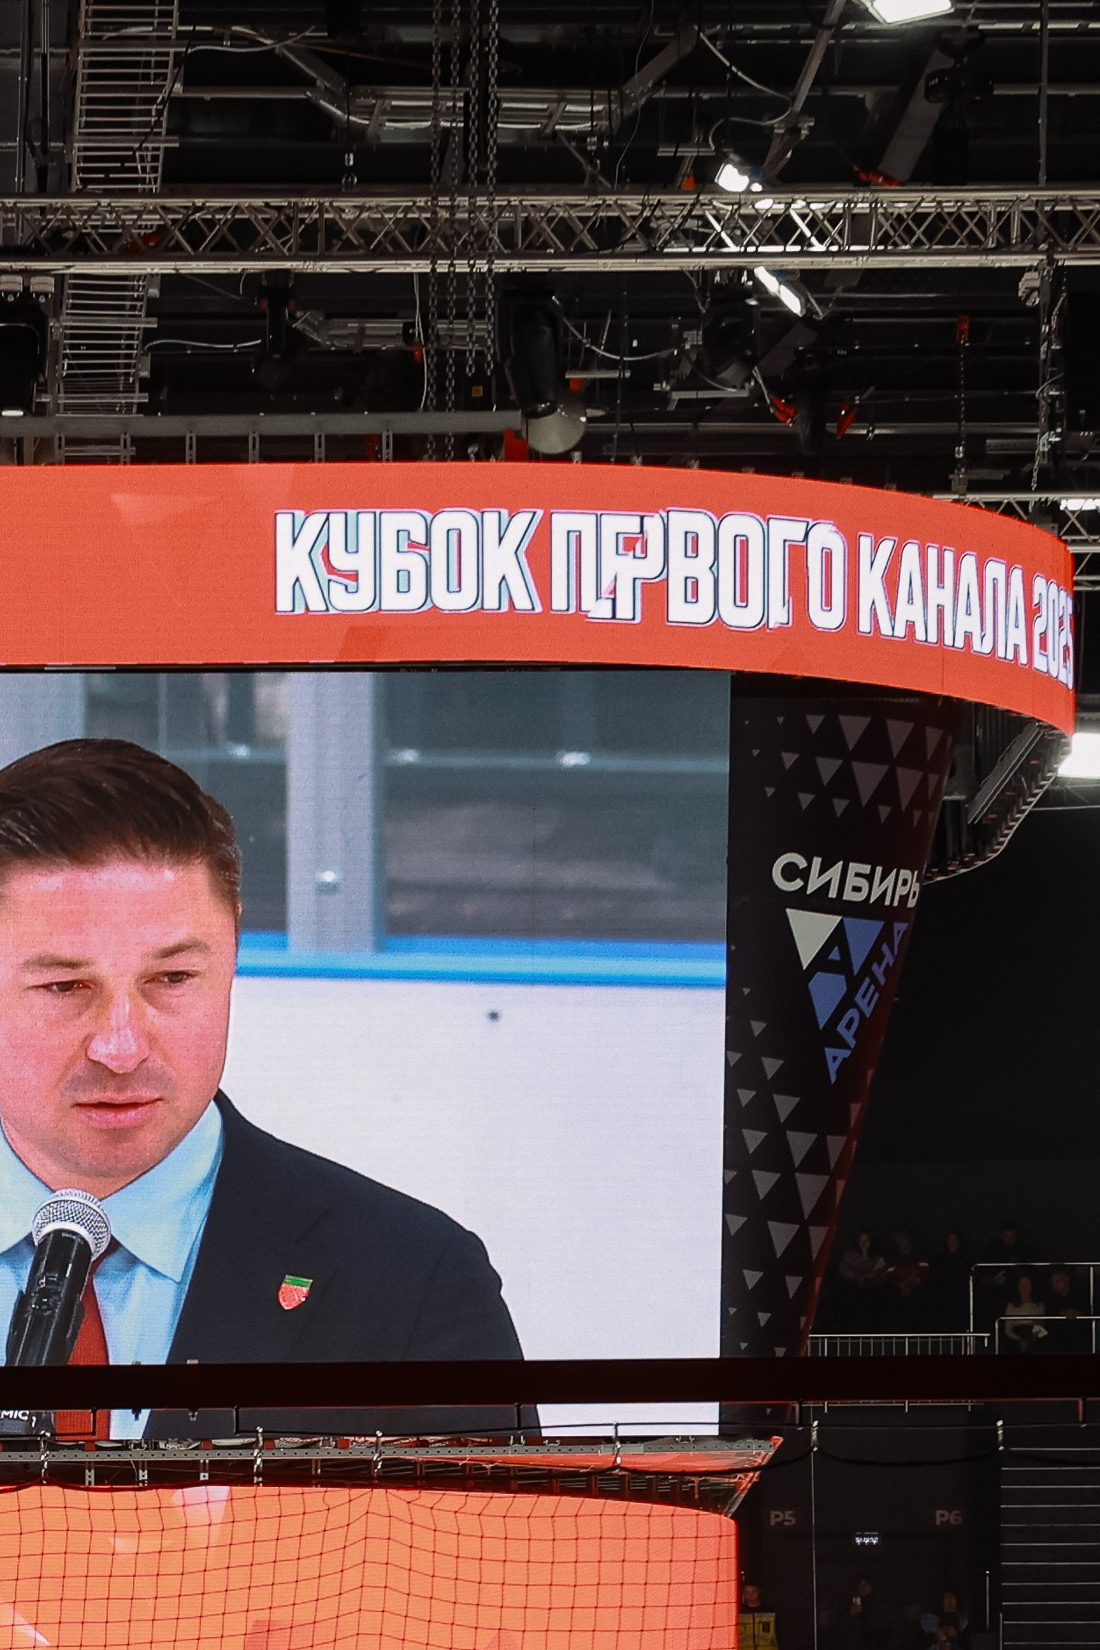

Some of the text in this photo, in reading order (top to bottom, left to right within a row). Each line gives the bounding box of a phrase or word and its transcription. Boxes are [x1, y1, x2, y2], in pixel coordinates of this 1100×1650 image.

[273, 508, 541, 614] КУБОК
[858, 532, 1028, 667] КАНАЛА
[772, 852, 921, 908] СИБИРЬ
[824, 922, 909, 1086] АРЕНА
